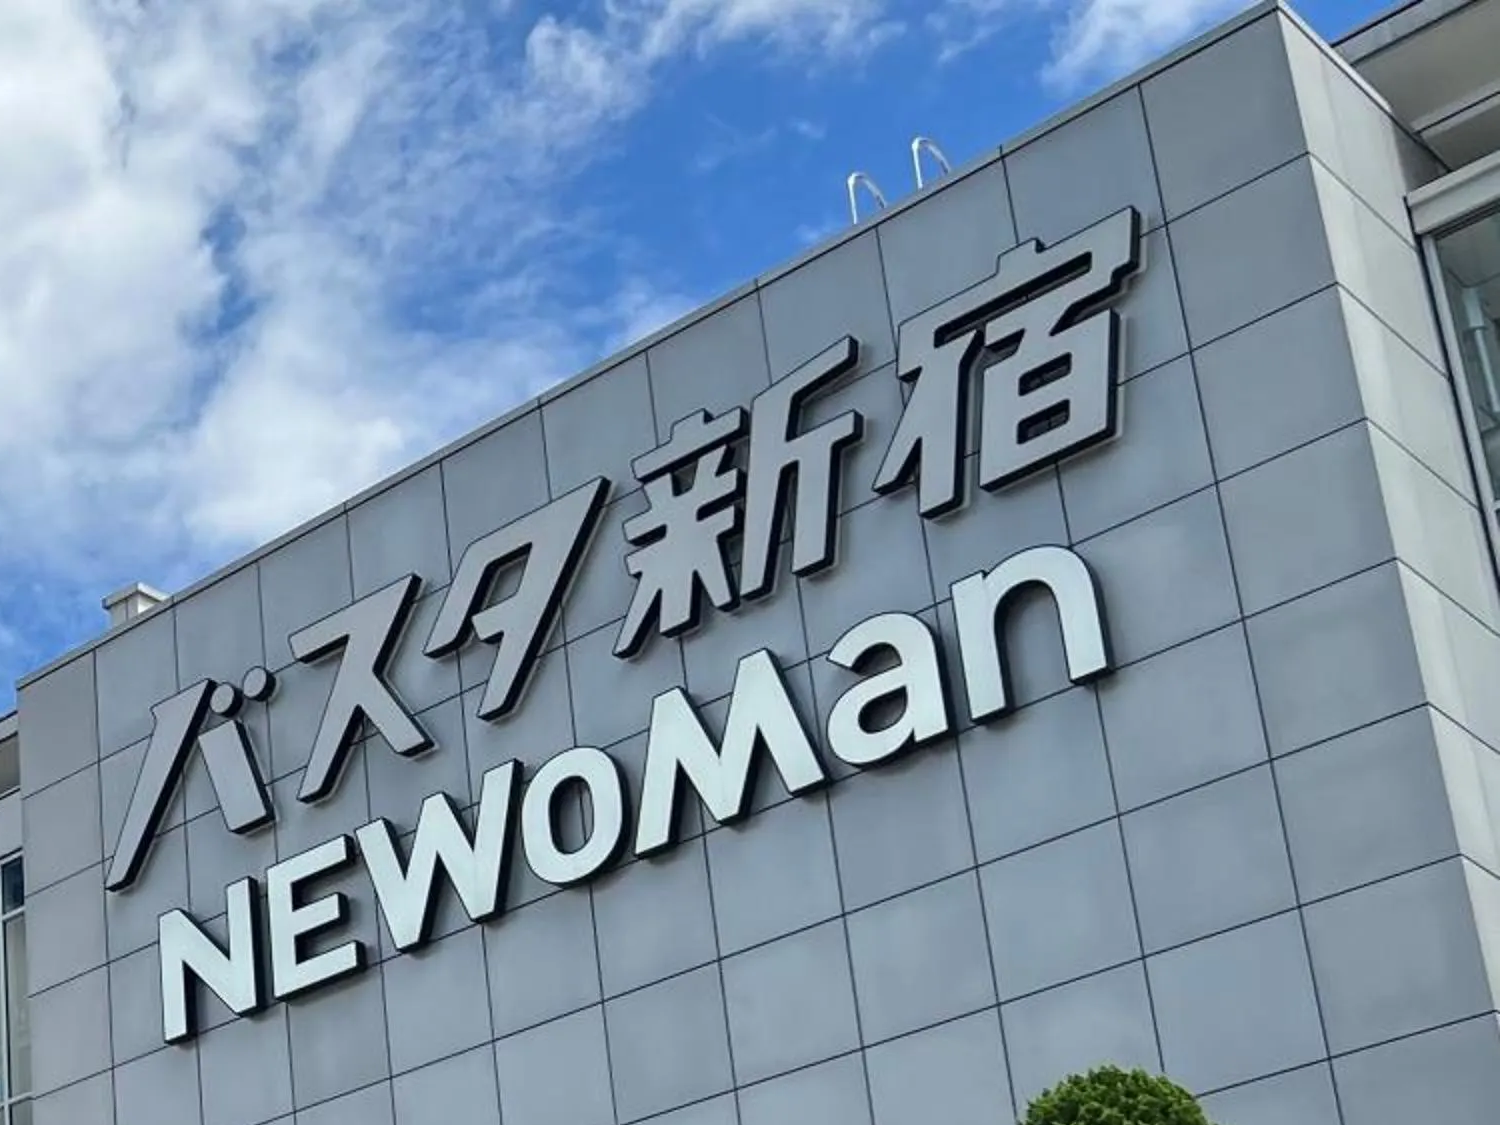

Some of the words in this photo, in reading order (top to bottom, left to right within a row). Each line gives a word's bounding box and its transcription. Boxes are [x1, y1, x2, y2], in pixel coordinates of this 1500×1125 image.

[105, 204, 1144, 893] バスタ新宿
